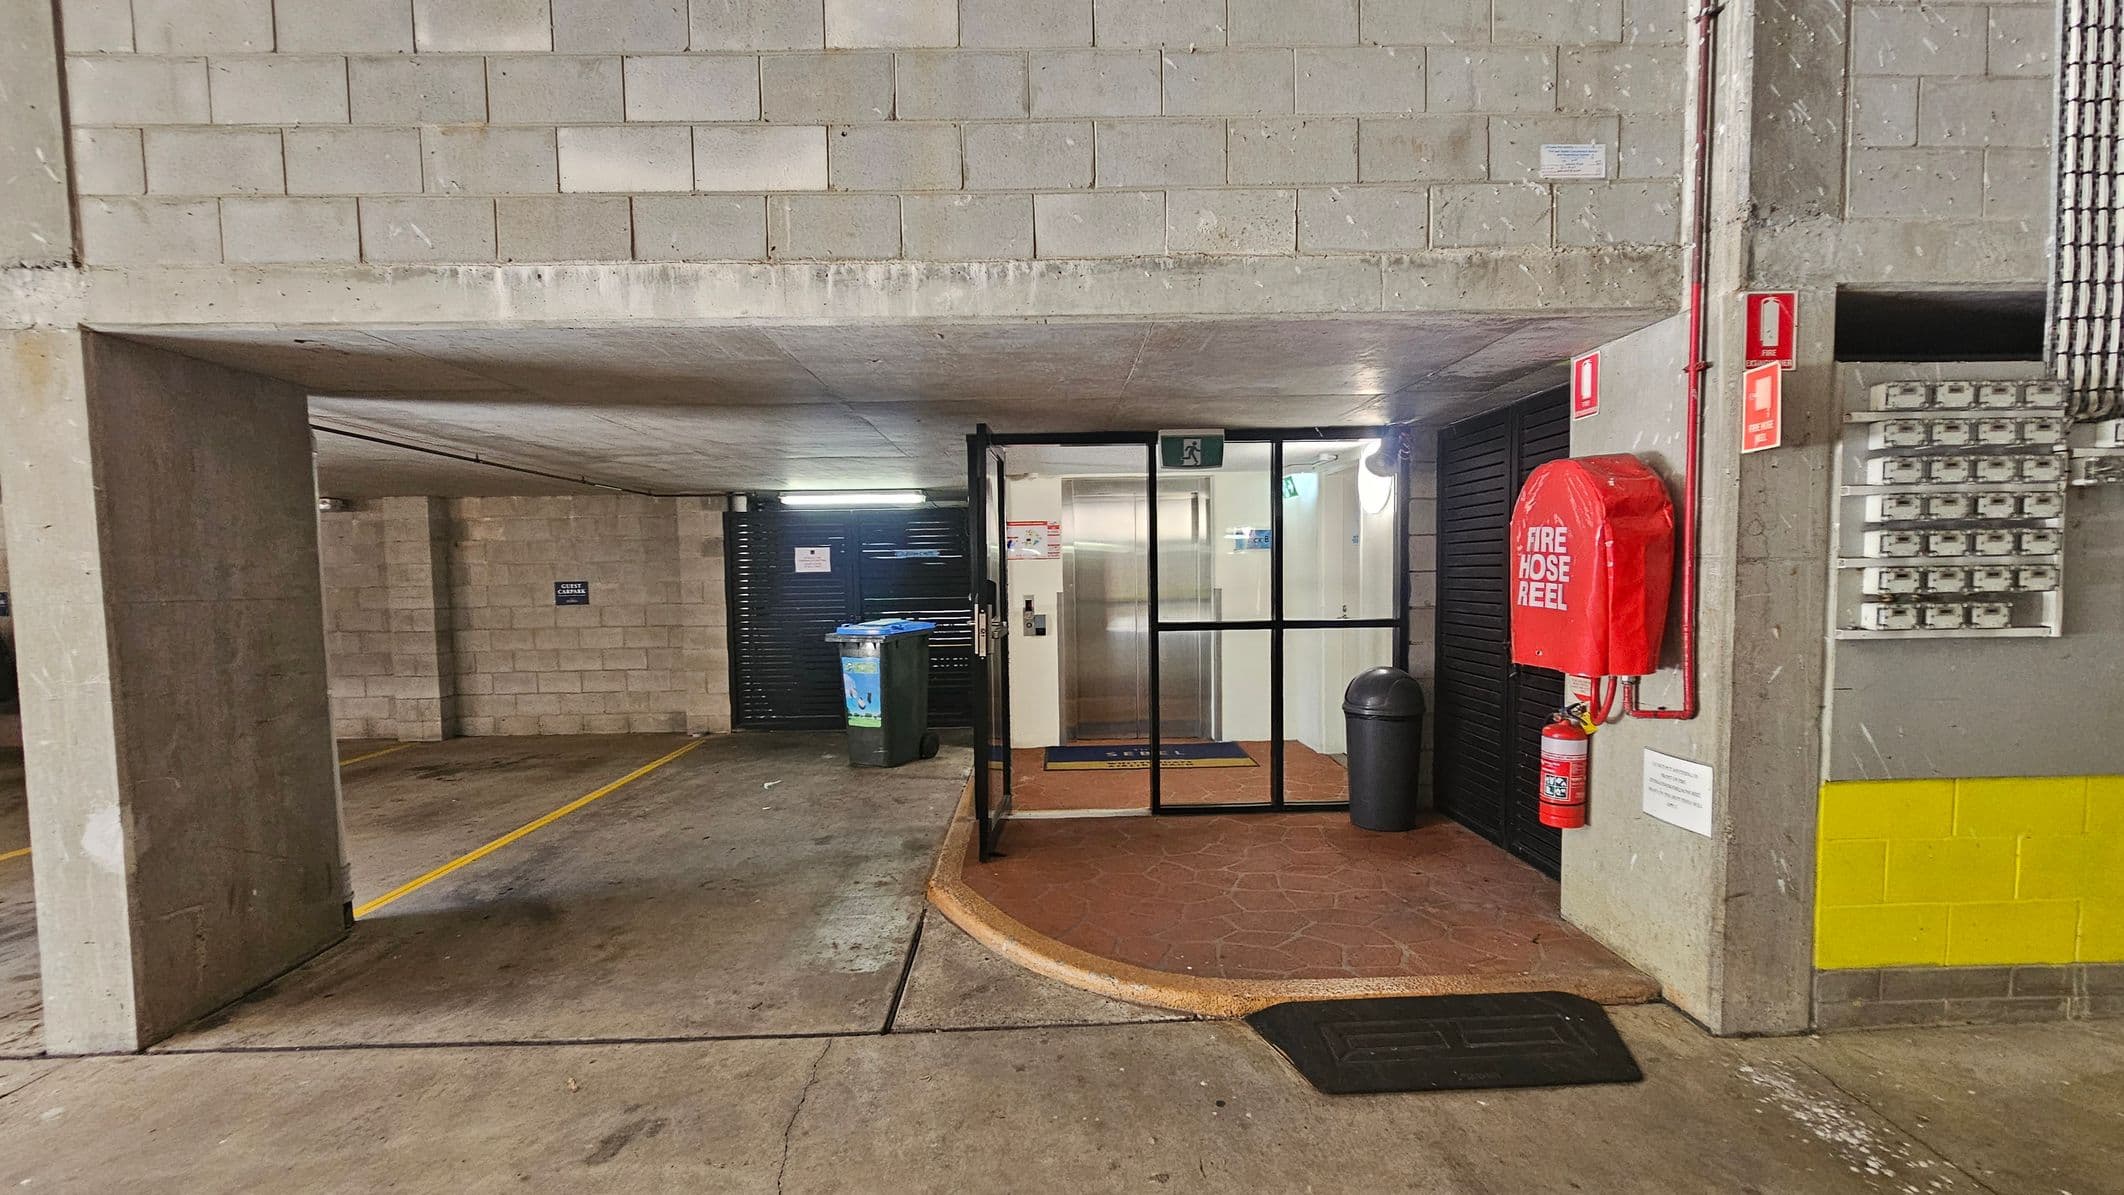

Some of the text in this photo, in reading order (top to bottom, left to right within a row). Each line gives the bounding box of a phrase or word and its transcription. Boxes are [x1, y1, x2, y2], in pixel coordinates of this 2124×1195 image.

[1761, 349, 1777, 357] FIRE
[1526, 526, 1568, 554] FIRE
[1519, 553, 1571, 583] HOSE
[1517, 580, 1568, 611] REEL
